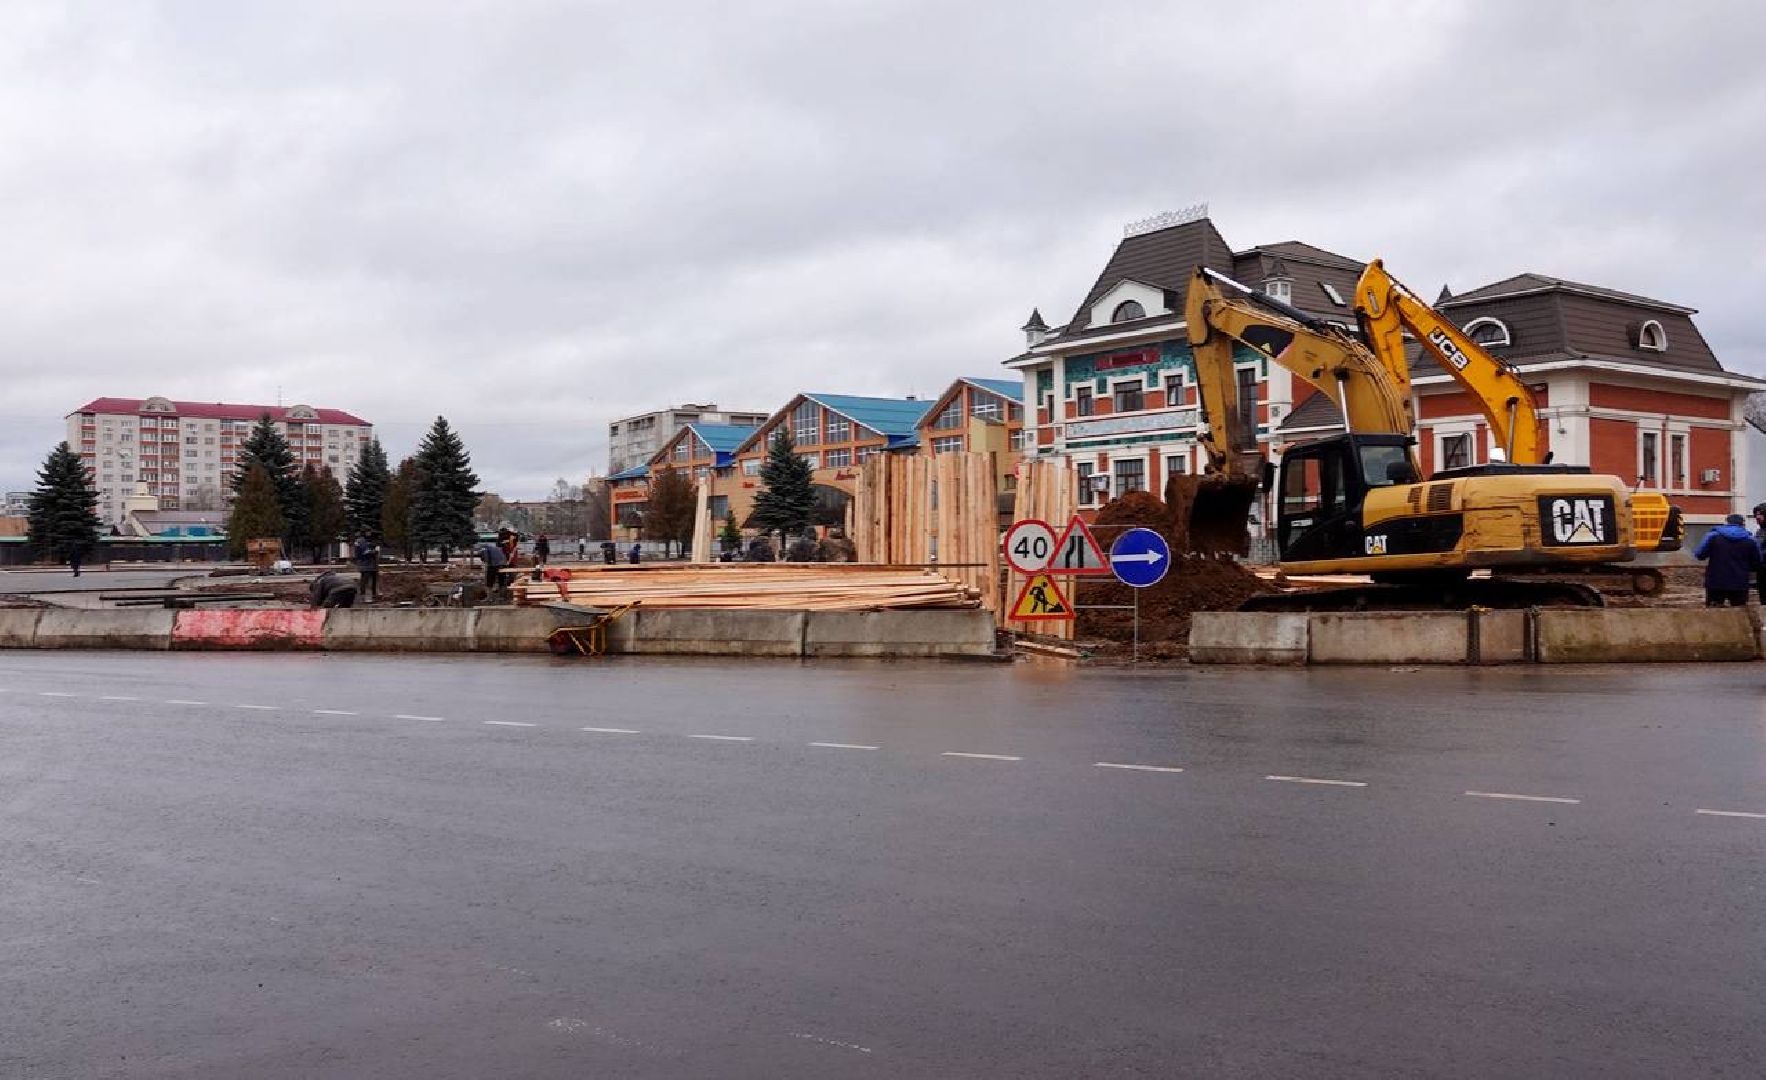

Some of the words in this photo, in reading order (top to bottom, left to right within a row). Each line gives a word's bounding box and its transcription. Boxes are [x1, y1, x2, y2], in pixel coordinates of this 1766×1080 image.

[1430, 328, 1468, 369] JCB
[1552, 499, 1605, 542] CAT
[1014, 536, 1048, 559] 40
[1365, 535, 1388, 555] CAT
